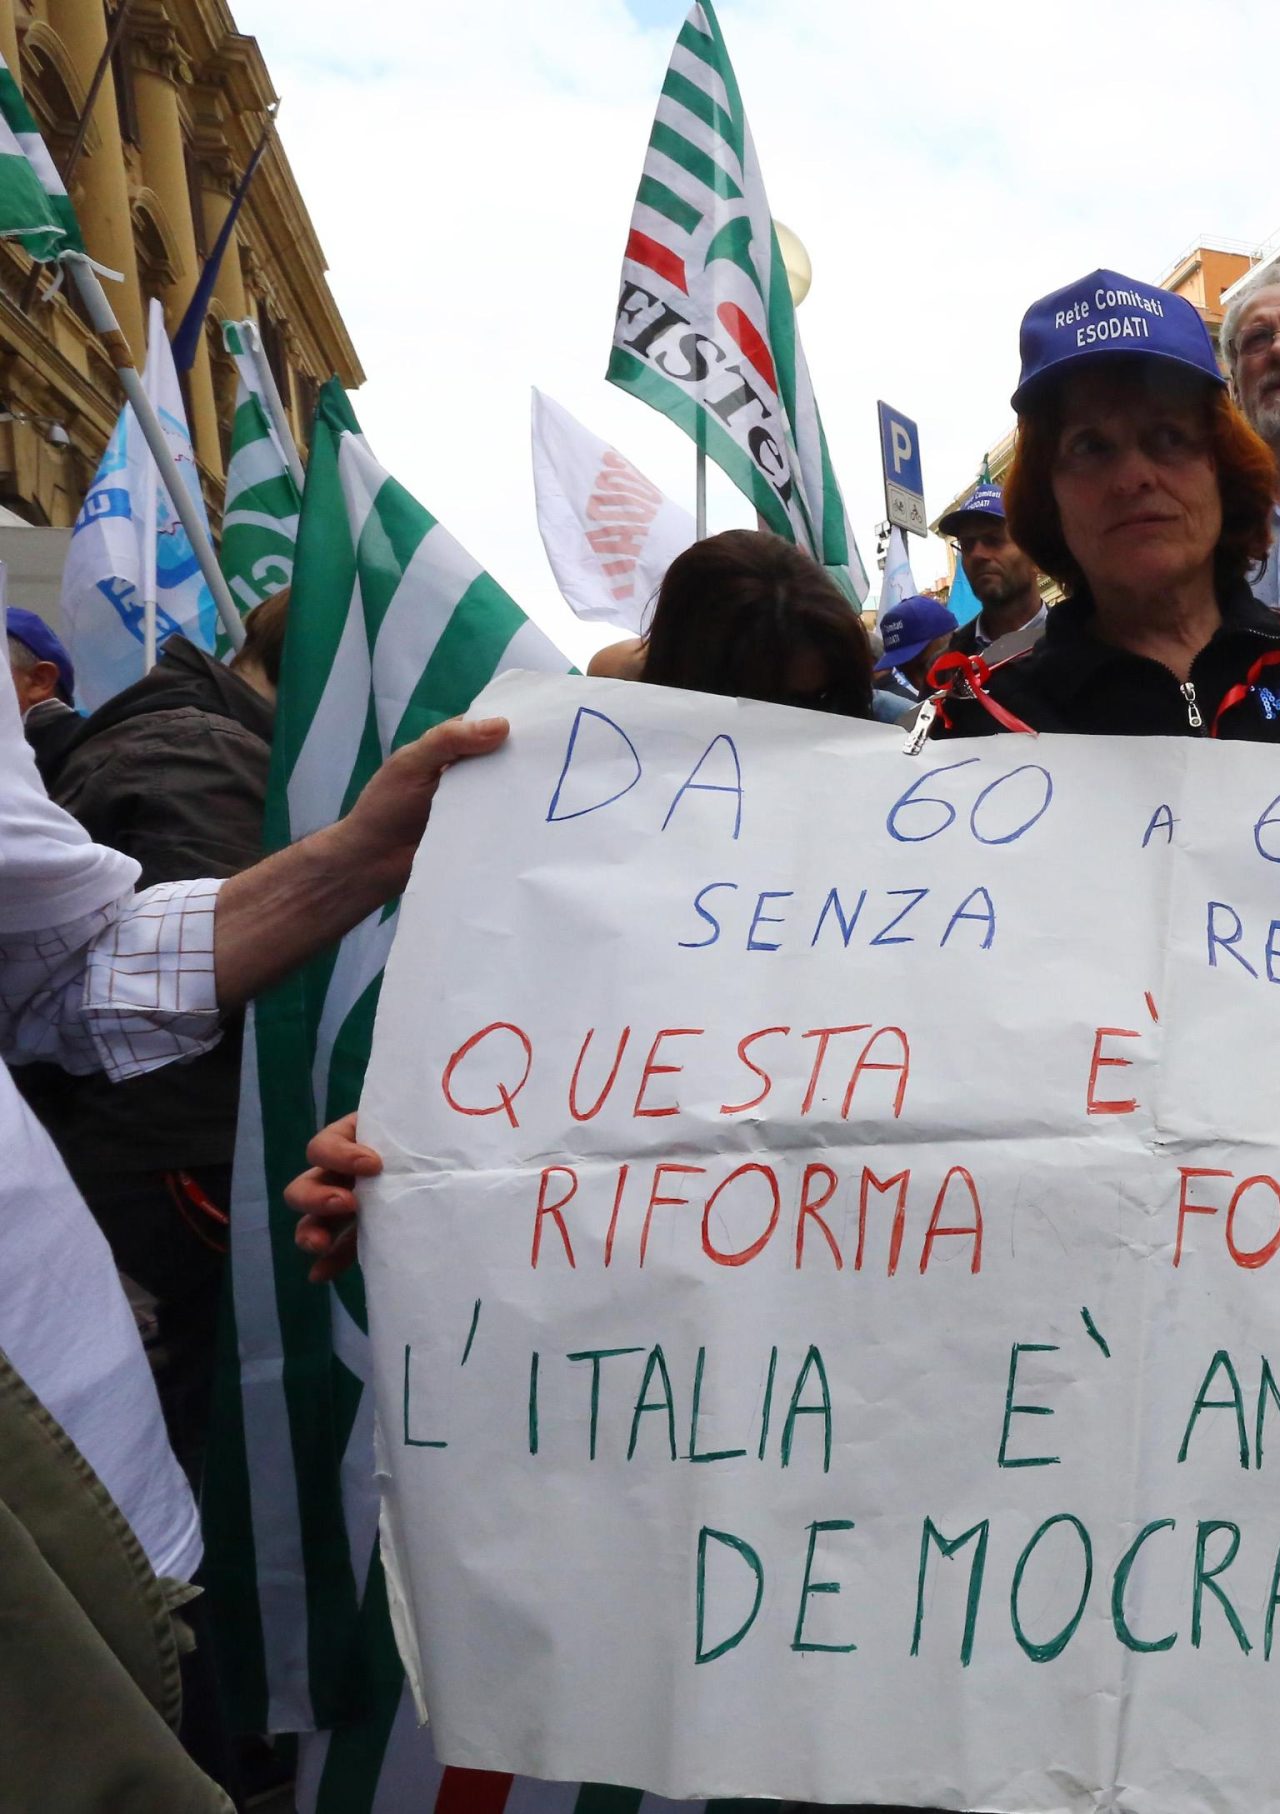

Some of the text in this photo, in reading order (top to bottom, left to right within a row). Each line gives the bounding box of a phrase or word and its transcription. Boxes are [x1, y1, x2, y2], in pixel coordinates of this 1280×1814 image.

[1055, 288, 1164, 329] Rete Comitati
[1076, 316, 1149, 347] ESODATI
[890, 420, 912, 474] P
[546, 706, 745, 840] DA
[886, 757, 1054, 845] 60
[1142, 804, 1179, 848] A
[678, 882, 999, 951] SENZA
[441, 1021, 912, 1128] QUESTA
[530, 1162, 985, 1277] RIFORMA
